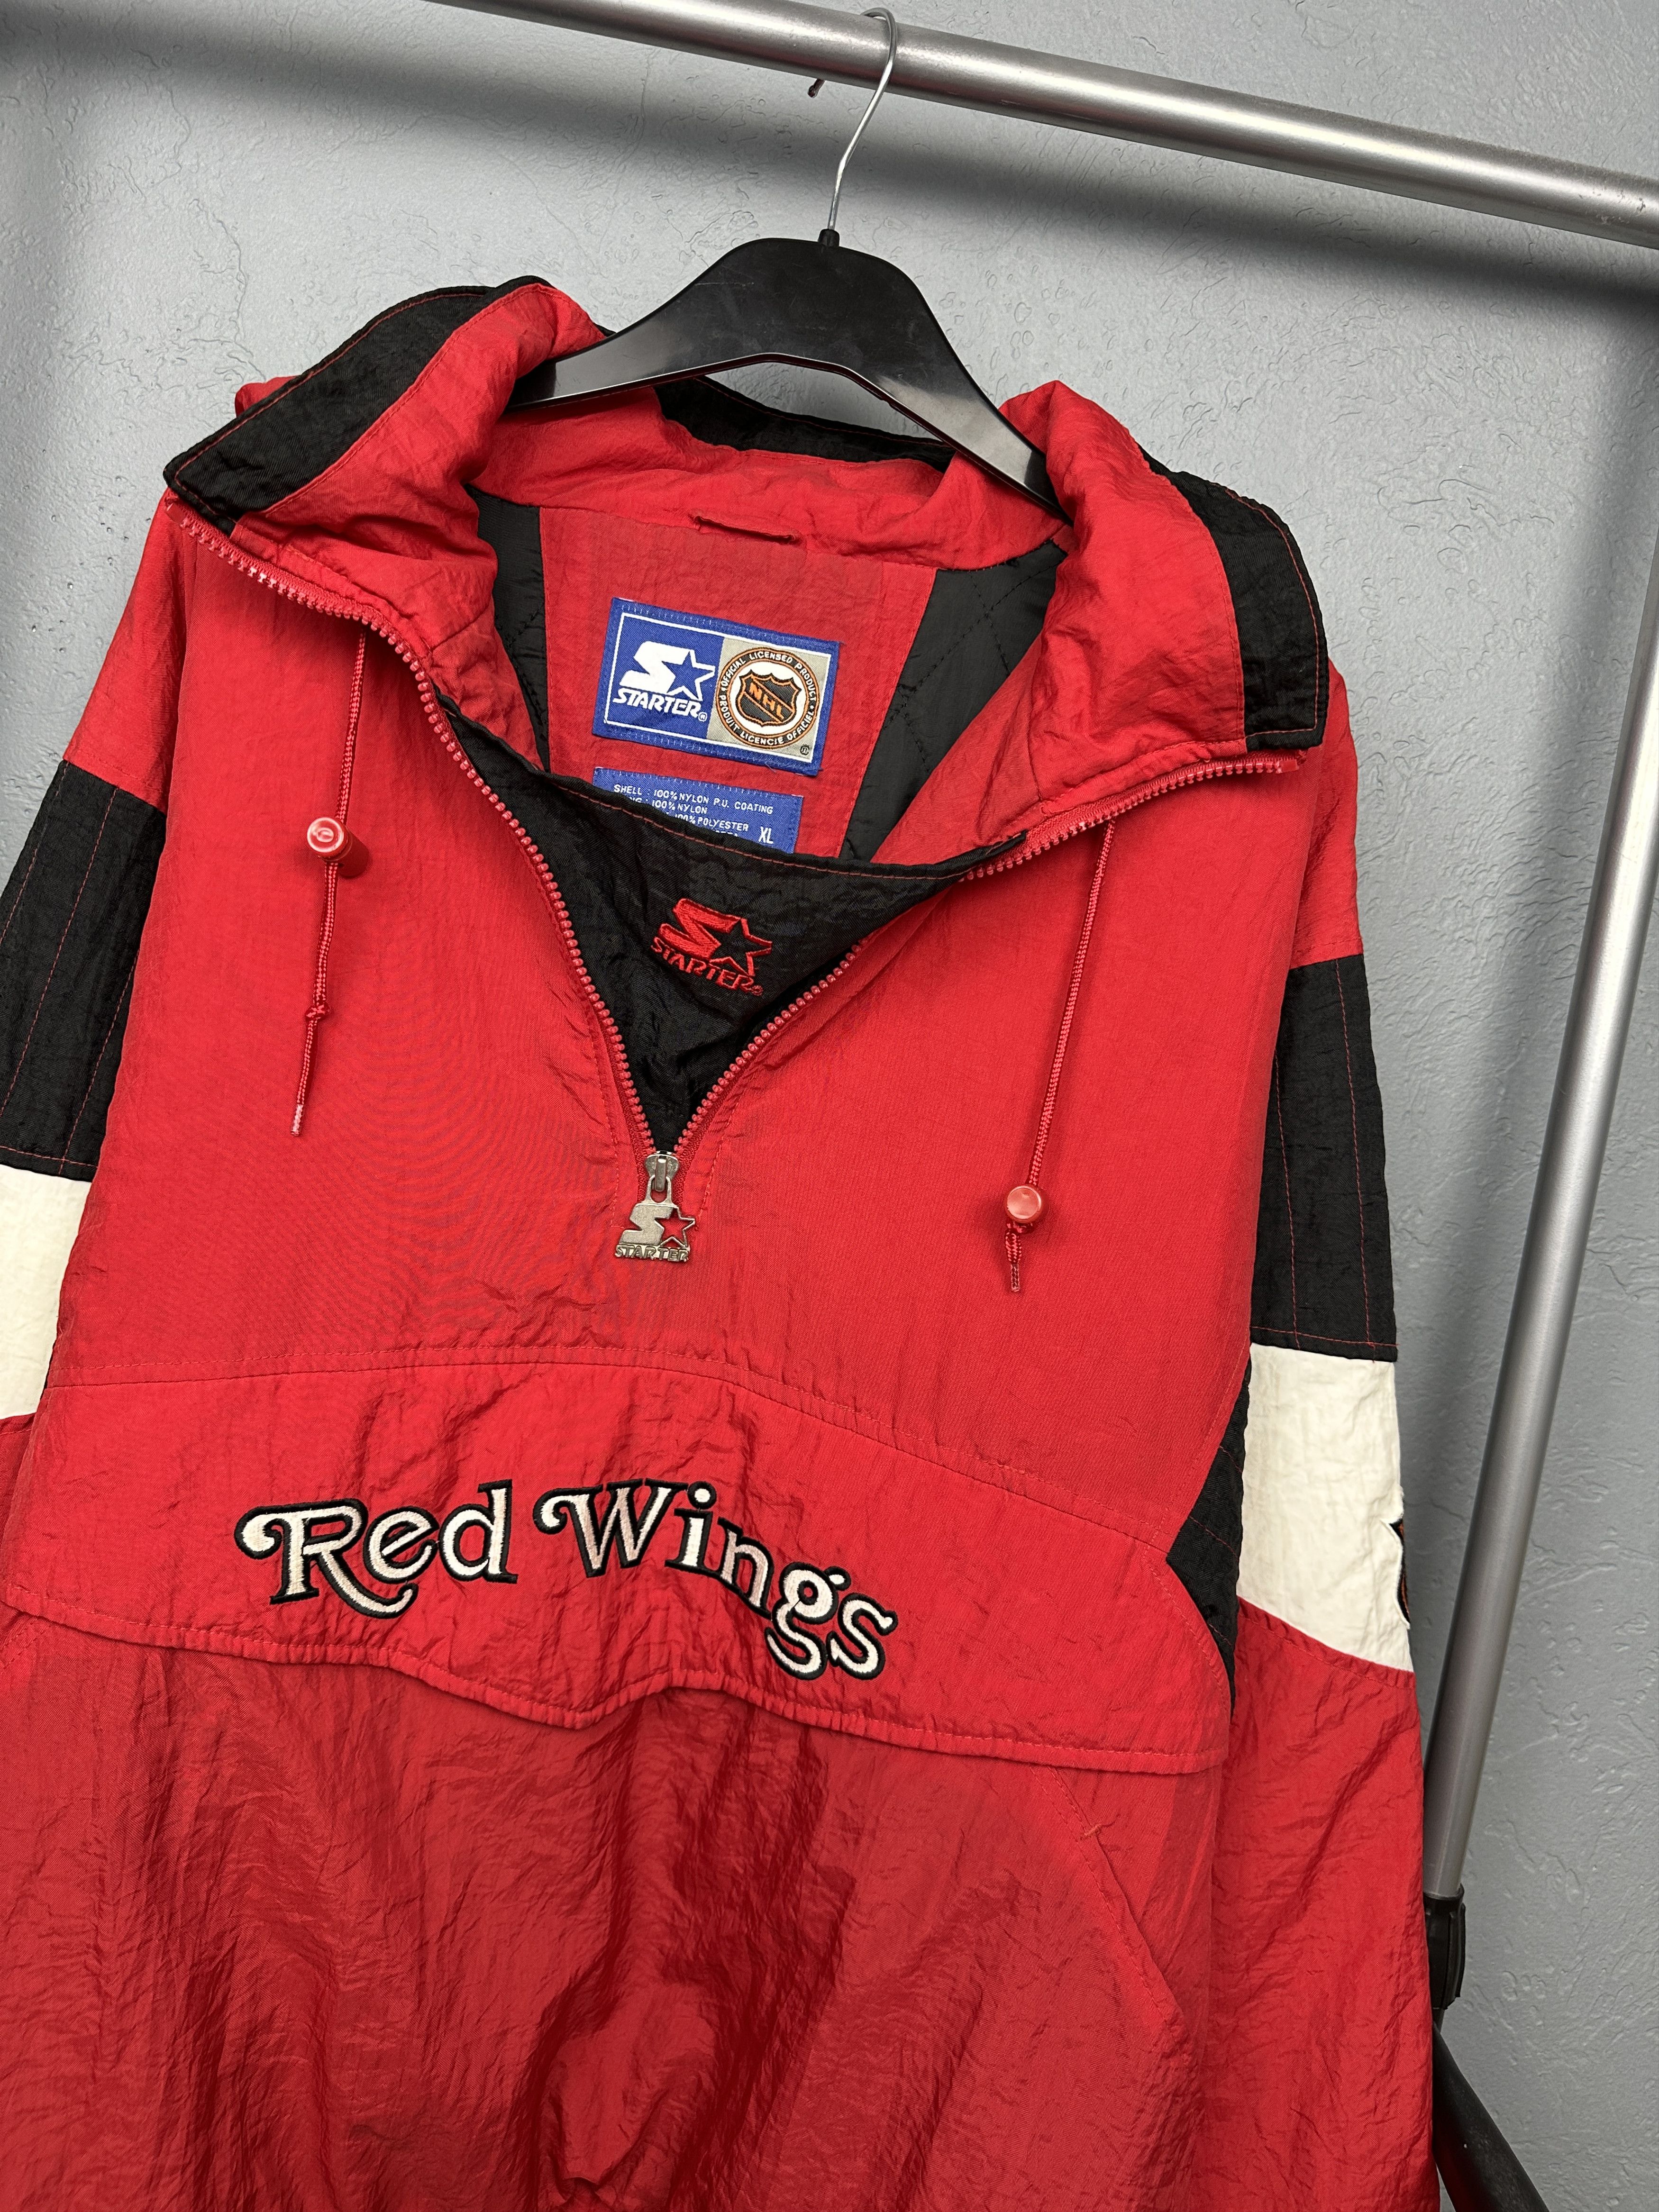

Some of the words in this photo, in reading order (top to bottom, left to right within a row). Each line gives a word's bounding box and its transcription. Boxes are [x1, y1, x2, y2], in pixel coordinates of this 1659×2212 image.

[720, 658, 747, 687] OFFICIAL
[749, 651, 793, 664] LICENSED
[794, 663, 817, 701] PRODUCT
[749, 682, 785, 719] NHL
[719, 695, 741, 731] PRODUIT
[786, 710, 814, 741] OFFICIEL
[613, 784, 642, 795] SHELL
[654, 789, 677, 801] 100%
[679, 792, 709, 804] NYLON
[735, 801, 774, 814] COATING
[652, 799, 675, 811] 100%
[677, 803, 708, 815] NYLON
[698, 816, 749, 832] POLYESTER
[758, 826, 774, 844] XL
[615, 1244, 690, 1262] STARTER
[234, 1478, 518, 1620] Red
[532, 1477, 898, 1681] Wings
